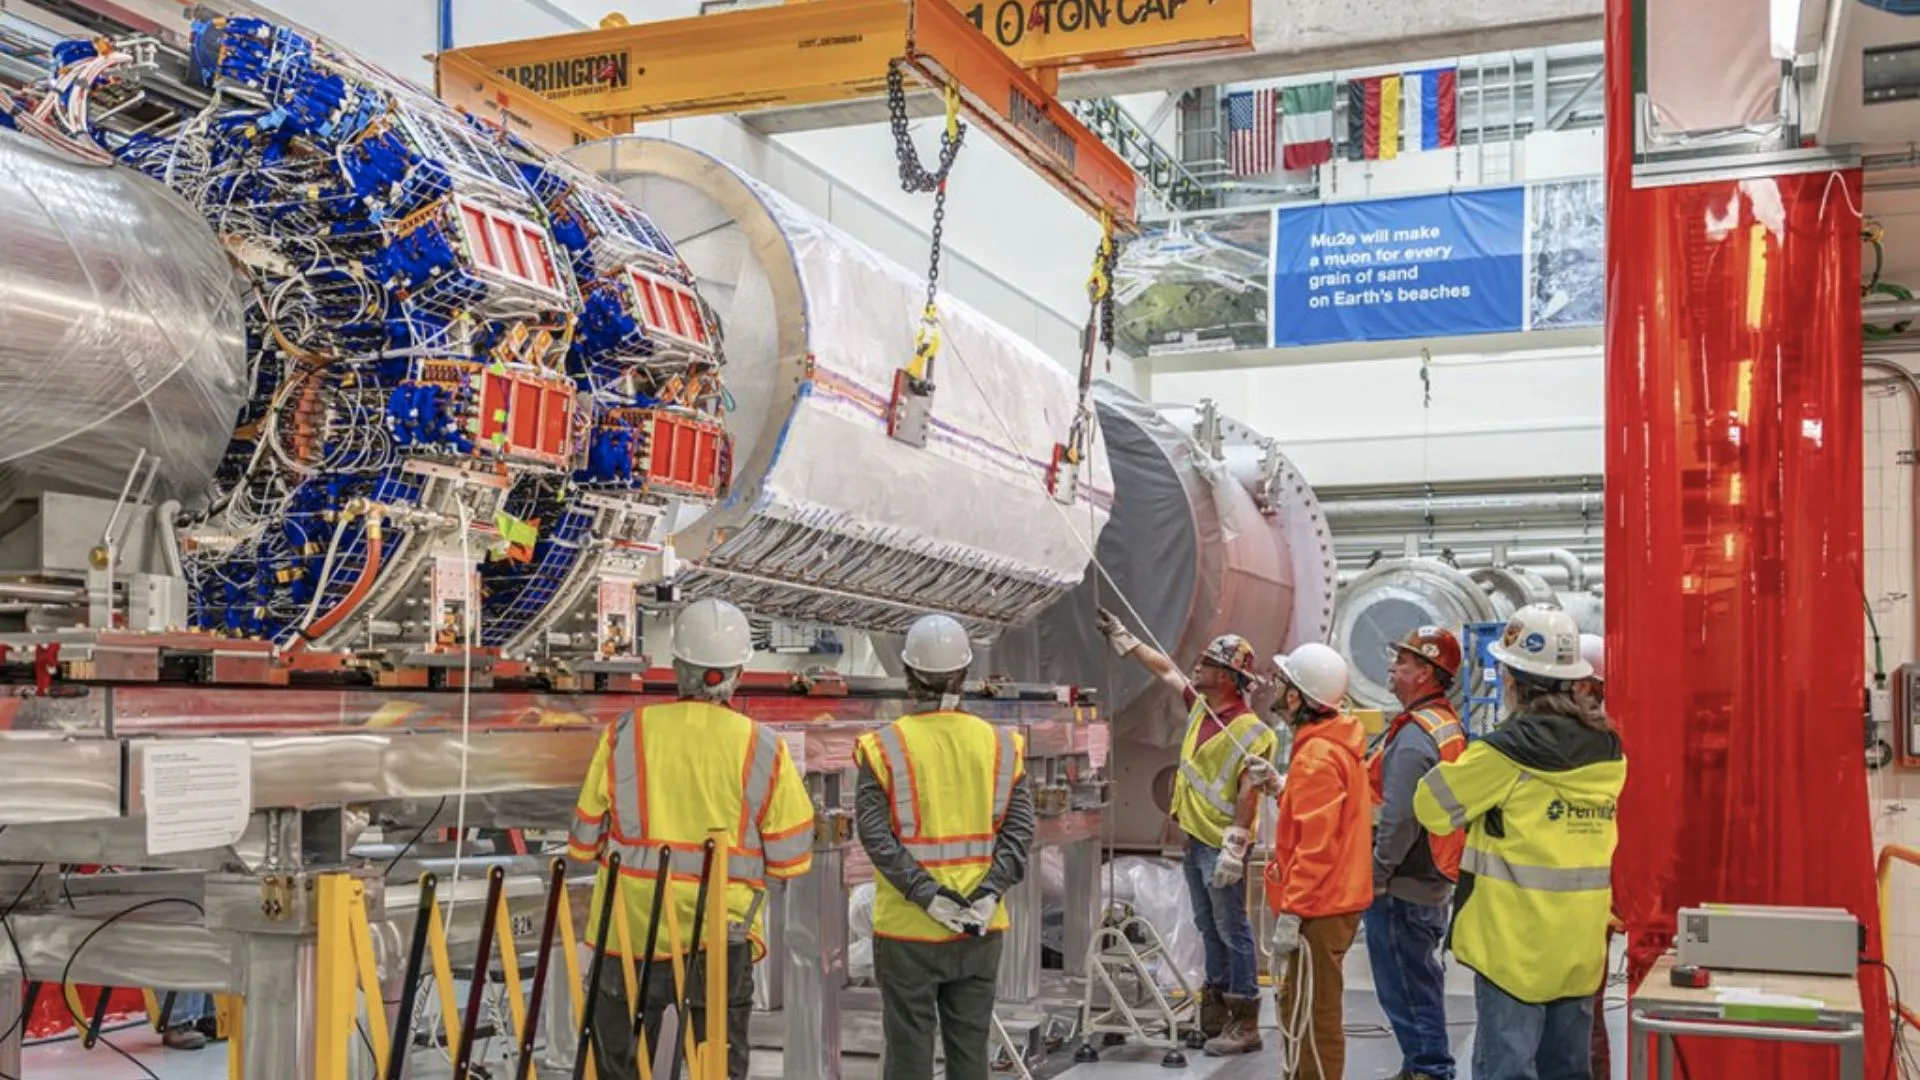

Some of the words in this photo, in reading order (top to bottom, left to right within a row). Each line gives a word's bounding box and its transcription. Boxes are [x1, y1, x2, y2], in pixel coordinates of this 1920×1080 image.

[1034, 0, 1111, 34] TON
[496, 52, 627, 93] ARRINGTON
[1310, 232, 1356, 248] Mu2e
[1360, 229, 1389, 245] will
[1393, 225, 1441, 242] make
[1309, 256, 1320, 267] a
[1324, 251, 1371, 266] muon
[1375, 247, 1401, 262] for
[1404, 244, 1453, 260] every
[1308, 271, 1351, 290] grain
[1355, 268, 1374, 284] of
[1377, 265, 1418, 282] sand
[1309, 295, 1330, 309] on
[1334, 288, 1394, 307] Earth's
[1398, 284, 1471, 301] beaches
